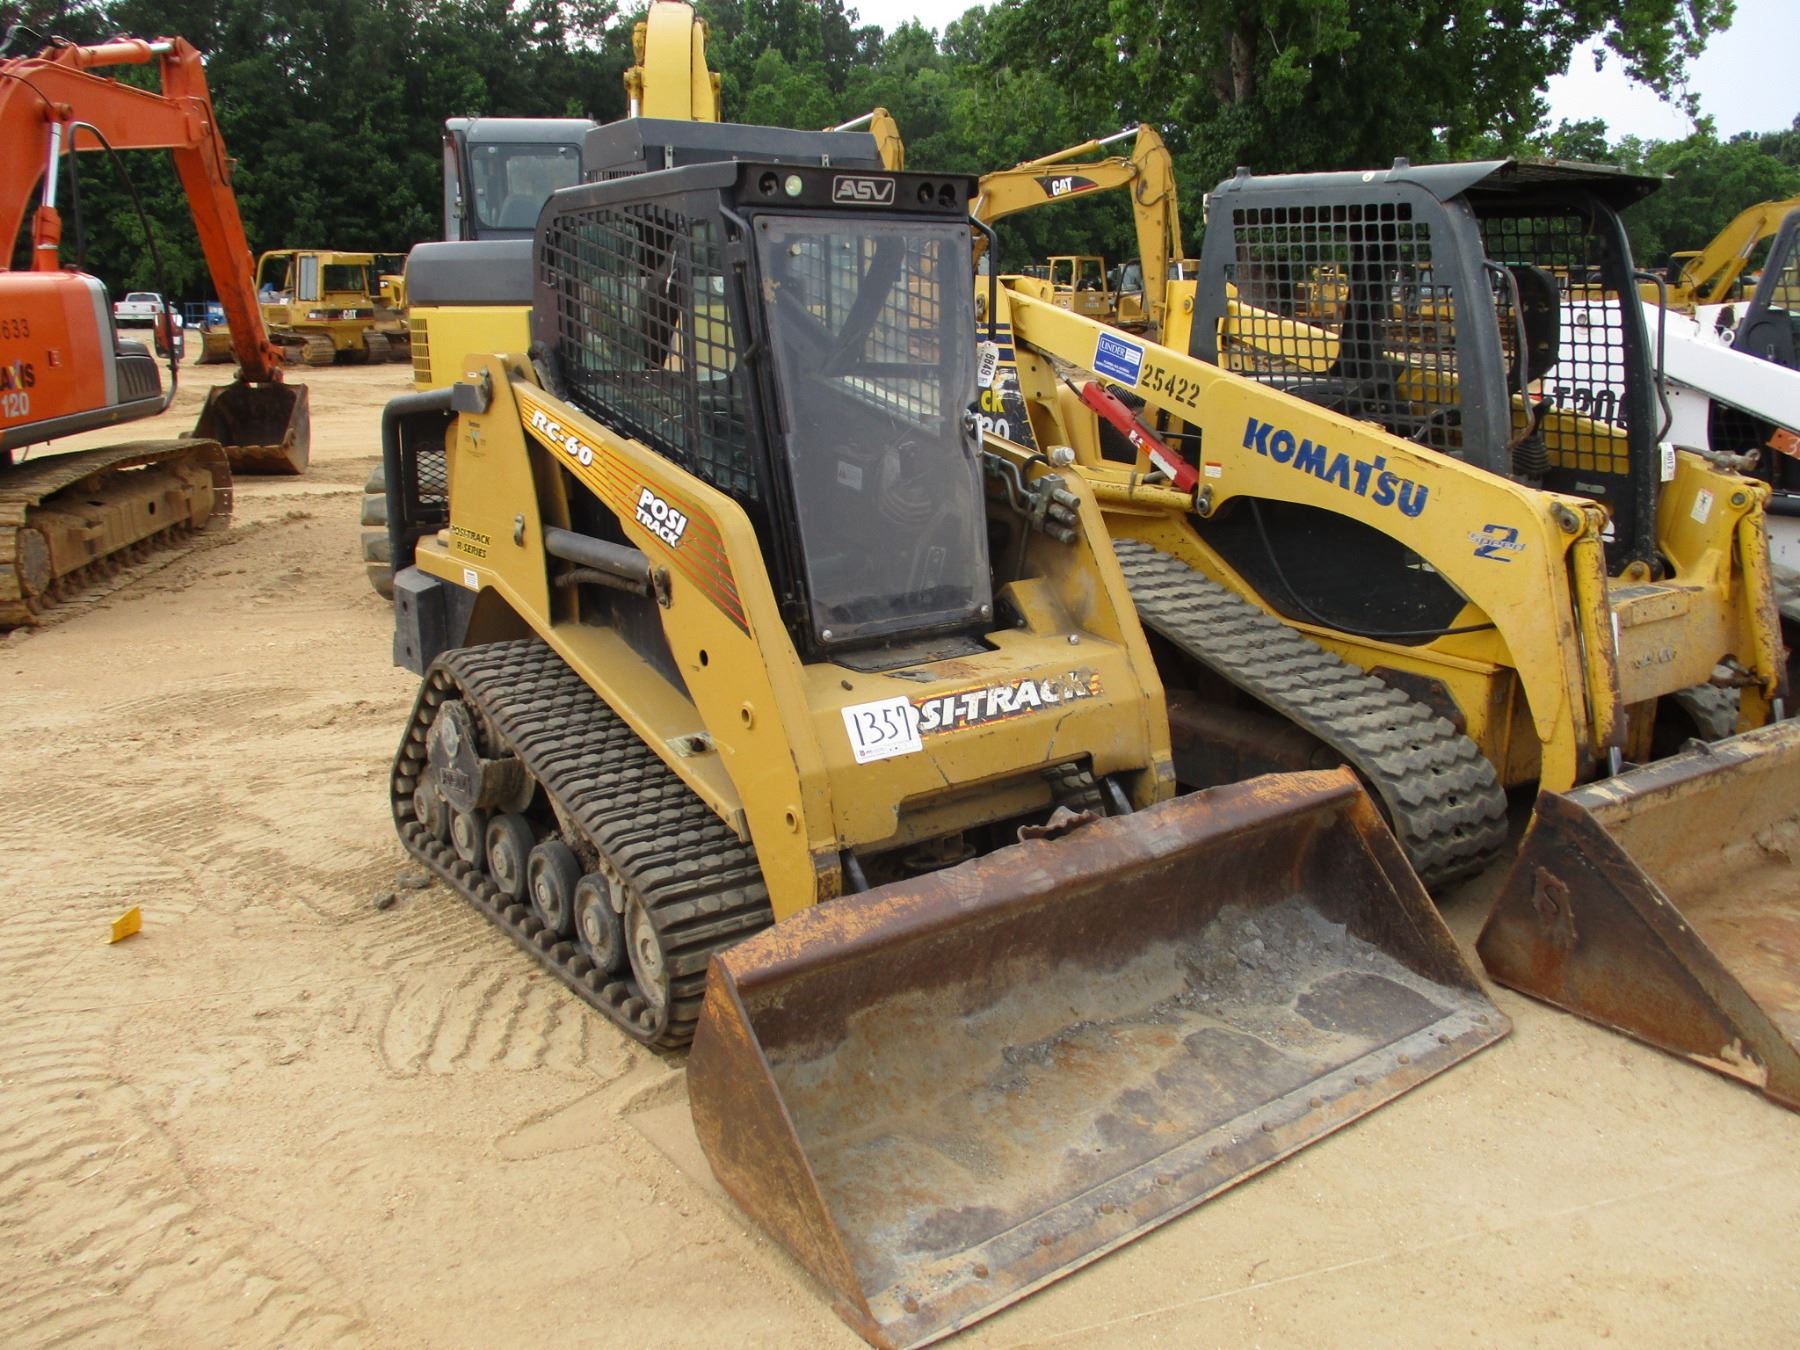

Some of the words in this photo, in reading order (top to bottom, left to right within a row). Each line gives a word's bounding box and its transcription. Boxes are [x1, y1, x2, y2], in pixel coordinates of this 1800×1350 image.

[836, 180, 892, 200] ASV
[1052, 177, 1072, 196] CAT
[343, 309, 357, 320] CAT
[1101, 339, 1126, 358] LINDER
[980, 353, 996, 376] 8849
[1141, 363, 1200, 408] 25422
[2, 391, 30, 418] 120
[981, 391, 1005, 412] CK
[530, 410, 593, 466] RC-60
[1242, 416, 1428, 517] KOMATSU
[638, 486, 688, 537] POSI
[635, 507, 680, 549] TRACK
[463, 543, 487, 558] SERIES
[911, 671, 1088, 732] SI-TRACK
